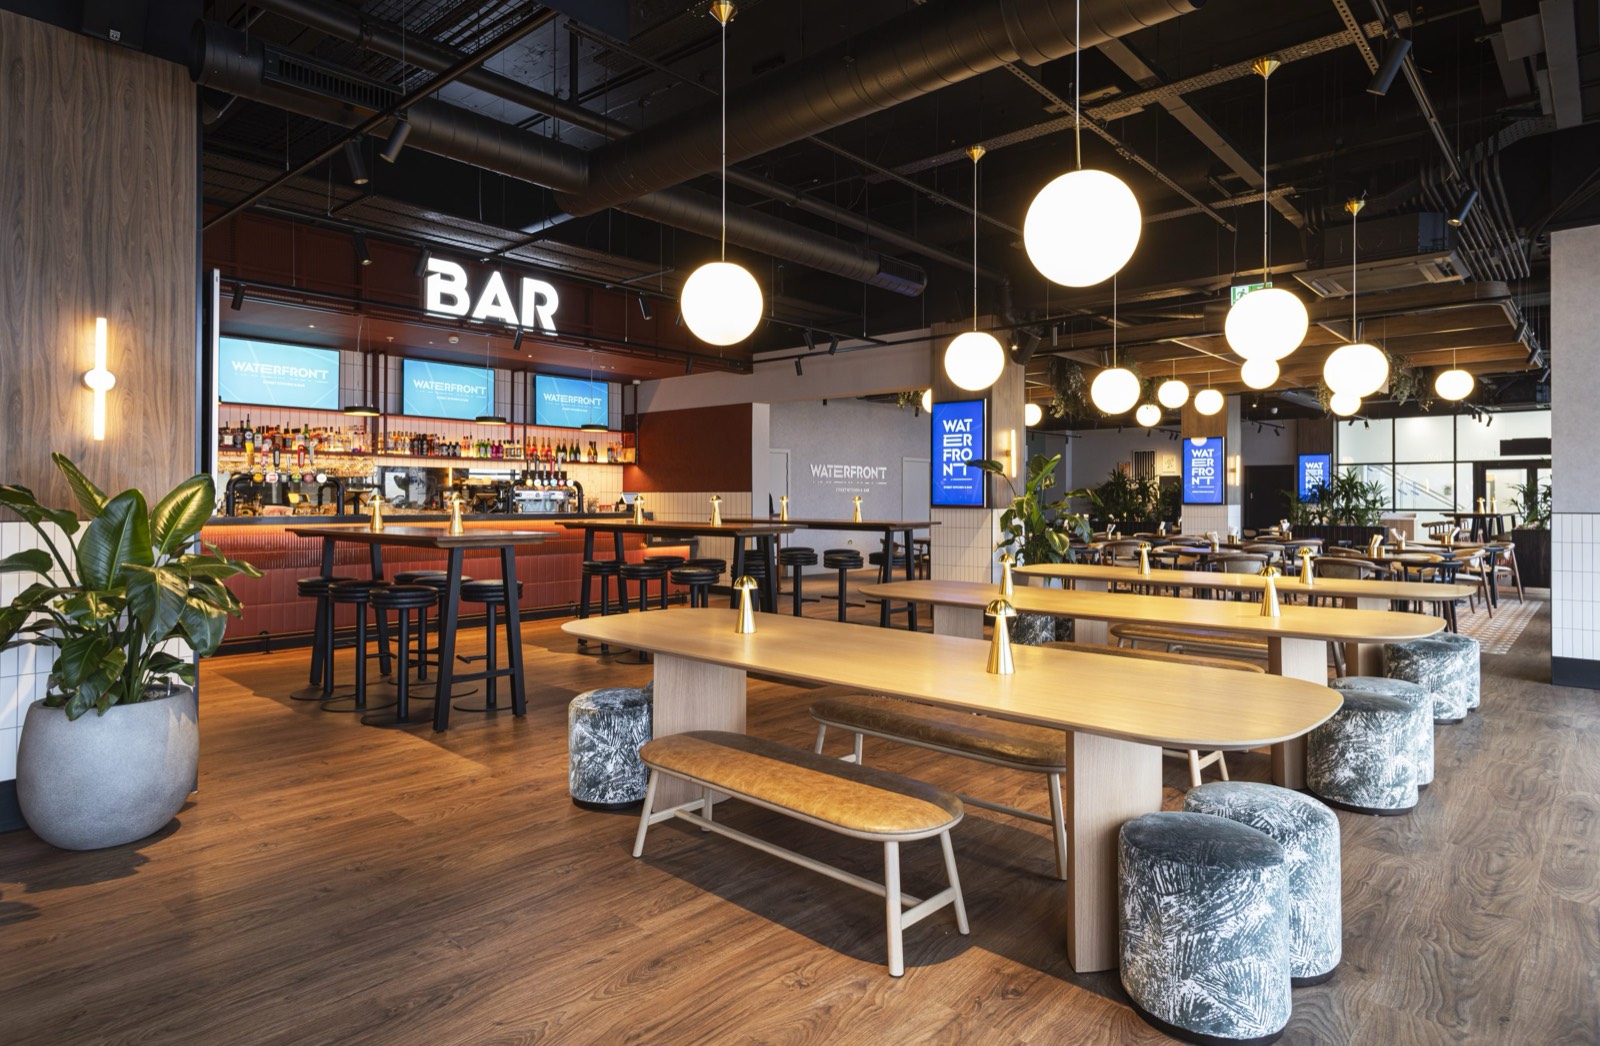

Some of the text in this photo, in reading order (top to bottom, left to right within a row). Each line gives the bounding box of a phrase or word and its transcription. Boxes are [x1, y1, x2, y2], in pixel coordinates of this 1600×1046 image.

[425, 257, 559, 336] BAR
[231, 361, 329, 380] WATERFRONT
[413, 379, 487, 396] WATERFRONT
[543, 393, 602, 406] WATERFRONT
[943, 418, 973, 432] WAT
[943, 433, 973, 447] ER
[943, 448, 973, 462] FRO
[1191, 448, 1214, 458] WAT
[1191, 458, 1214, 467] ER
[810, 464, 887, 479] WATERFRONT
[1191, 467, 1214, 476] FRO
[1191, 476, 1214, 486] NT
